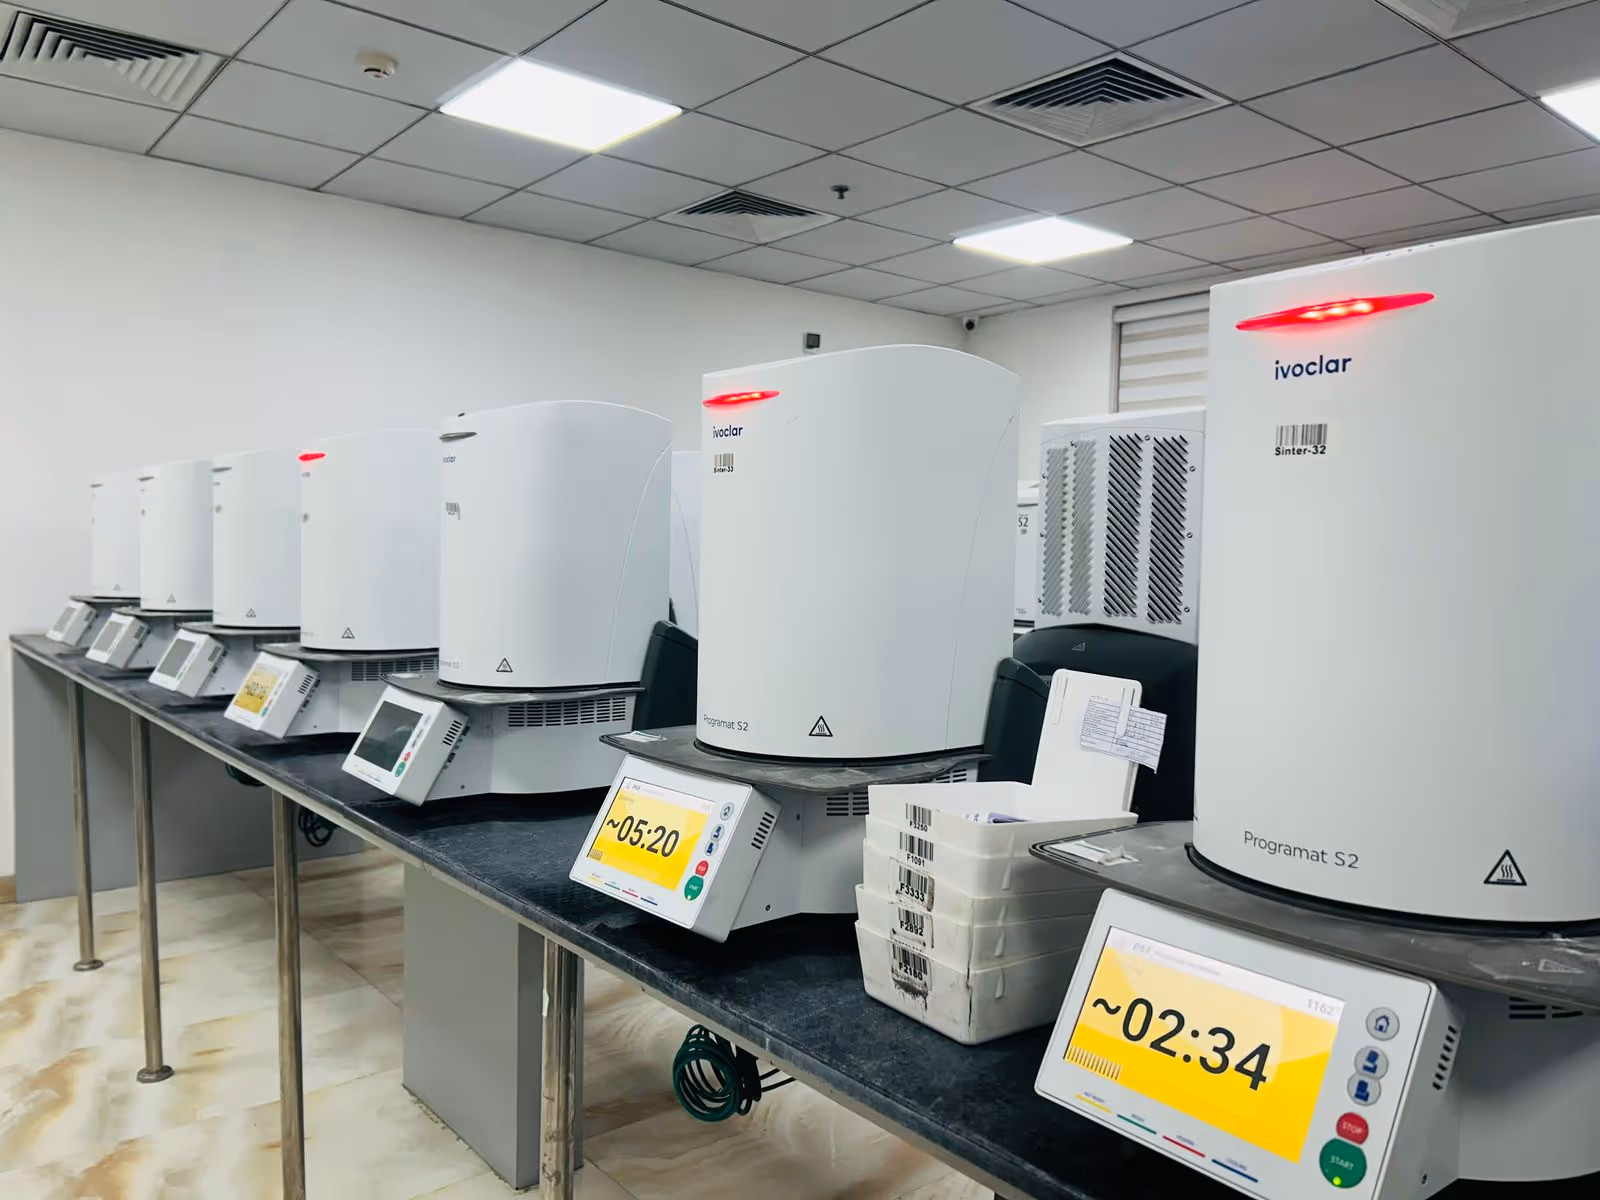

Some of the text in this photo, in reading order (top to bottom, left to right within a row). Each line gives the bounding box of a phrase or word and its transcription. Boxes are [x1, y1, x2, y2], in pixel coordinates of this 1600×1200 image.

[1274, 355, 1352, 380] ivoclar
[712, 425, 744, 439] ivoclar
[1274, 445, 1327, 456] Sinter-32
[1017, 516, 1029, 528] S2
[737, 720, 749, 732] S2
[909, 820, 928, 832] F3250
[606, 815, 680, 858] ~05:20
[1244, 830, 1360, 870] Programat S2
[906, 853, 925, 867] F1091
[899, 882, 925, 902] F3333
[899, 920, 924, 937] F2892
[898, 961, 923, 981] F2180
[1091, 996, 1272, 1092] ~02:34
[1342, 1121, 1363, 1134] STOP
[1329, 1154, 1355, 1171] START
